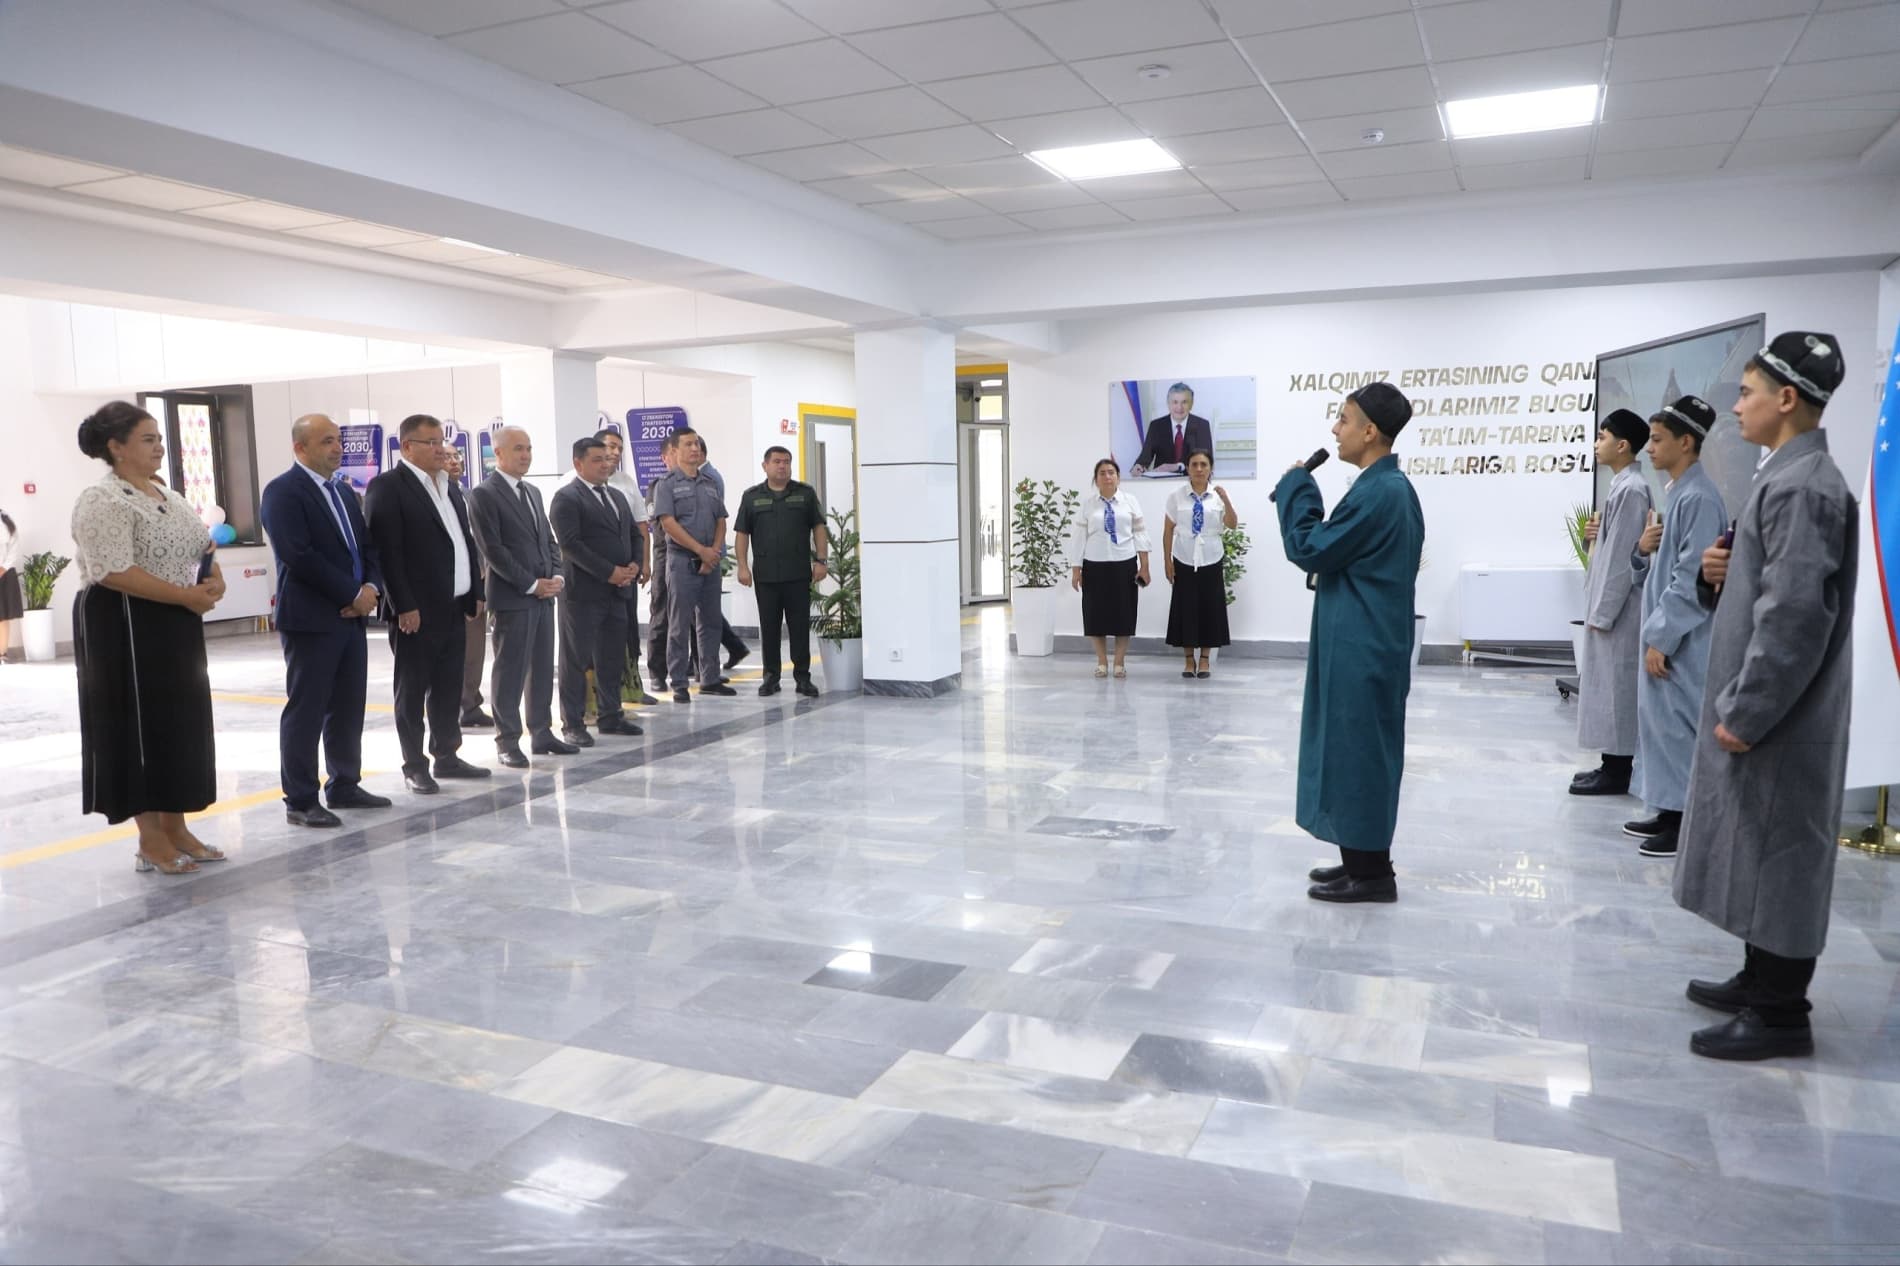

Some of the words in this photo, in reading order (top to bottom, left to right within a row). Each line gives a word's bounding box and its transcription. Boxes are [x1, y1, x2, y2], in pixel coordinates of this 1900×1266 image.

[1289, 370, 1389, 394] XALQIMIZ
[1400, 364, 1529, 388] ERTASINING
[1541, 362, 1596, 387] QAN
[1529, 393, 1595, 413] BUGU
[641, 425, 674, 439] 2030
[343, 439, 369, 453] 2030
[1398, 455, 1516, 475] ISHLARIGA
[1525, 452, 1594, 474] BOG'L
